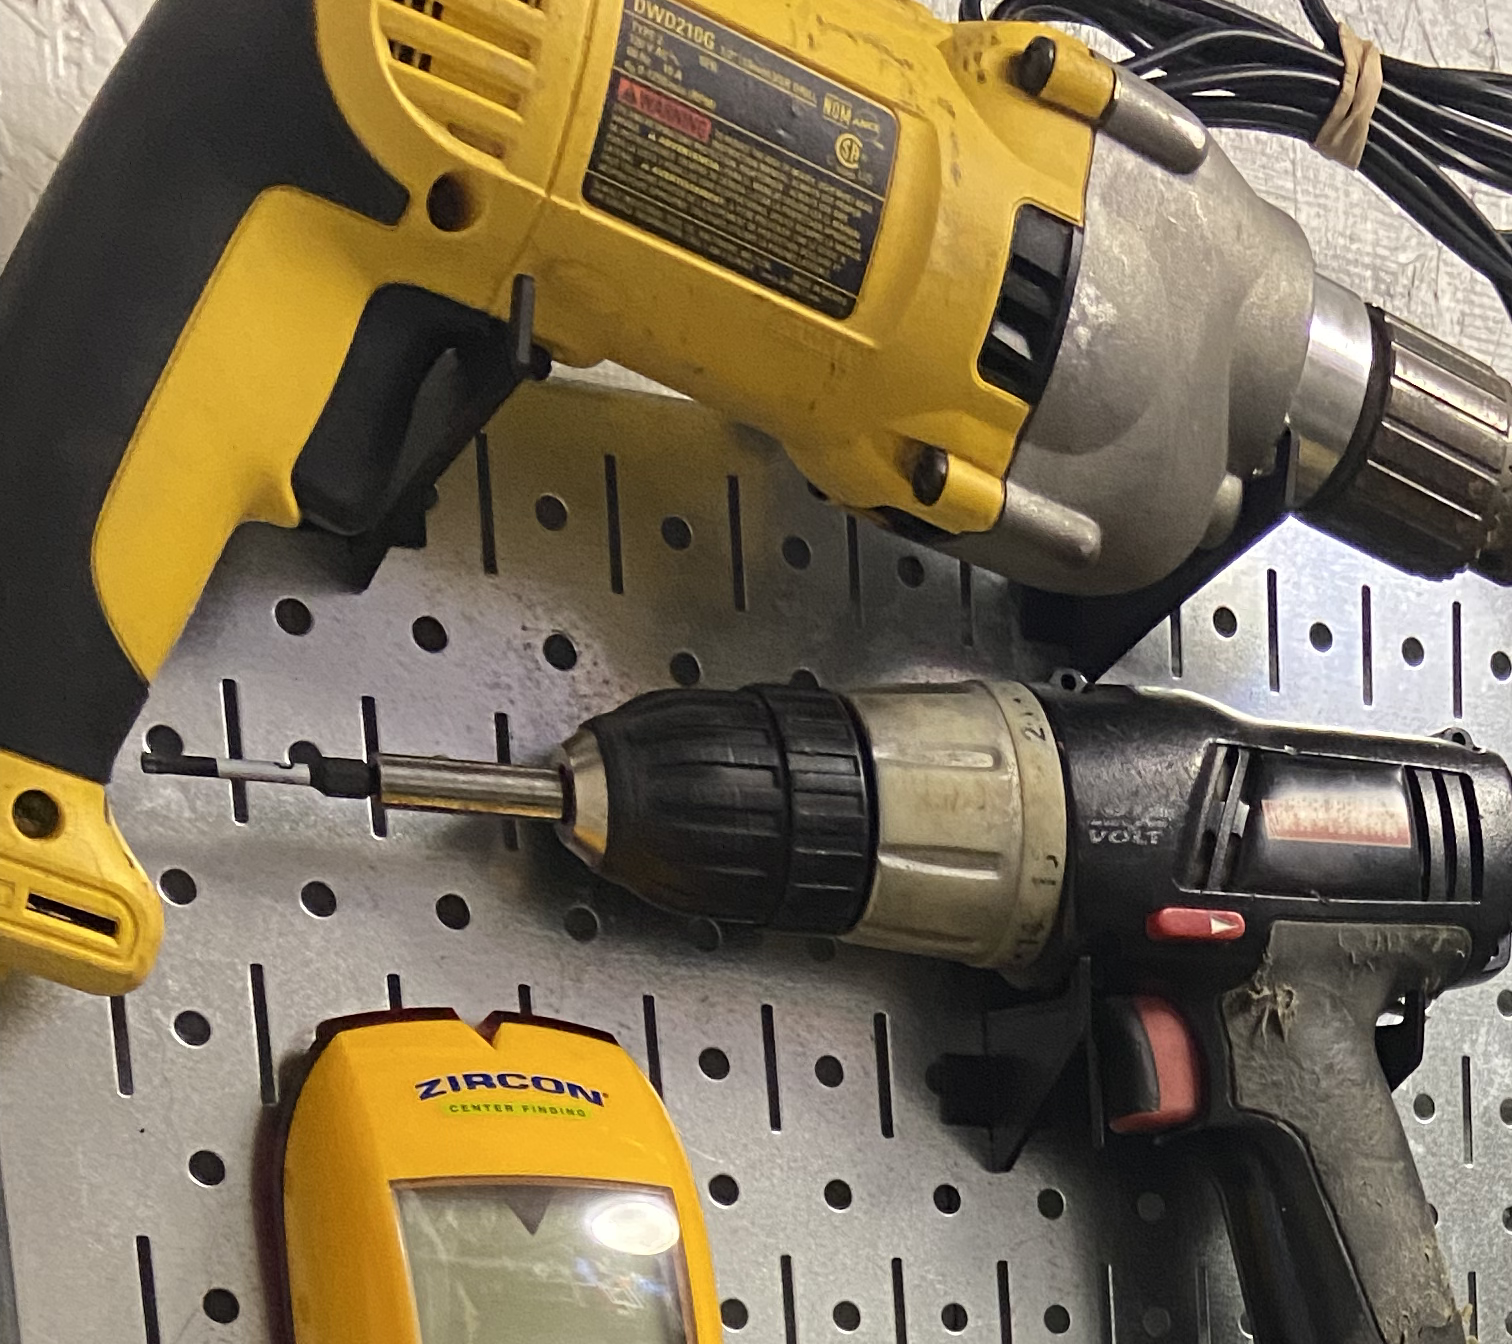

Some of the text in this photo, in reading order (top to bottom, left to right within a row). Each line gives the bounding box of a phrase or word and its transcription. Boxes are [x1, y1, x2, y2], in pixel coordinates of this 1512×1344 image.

[634, 0, 716, 50] DWD210G
[1088, 828, 1163, 847] VOLT
[415, 1073, 605, 1107] ZIRCON
[449, 1103, 587, 1118] CENTER FINDING
